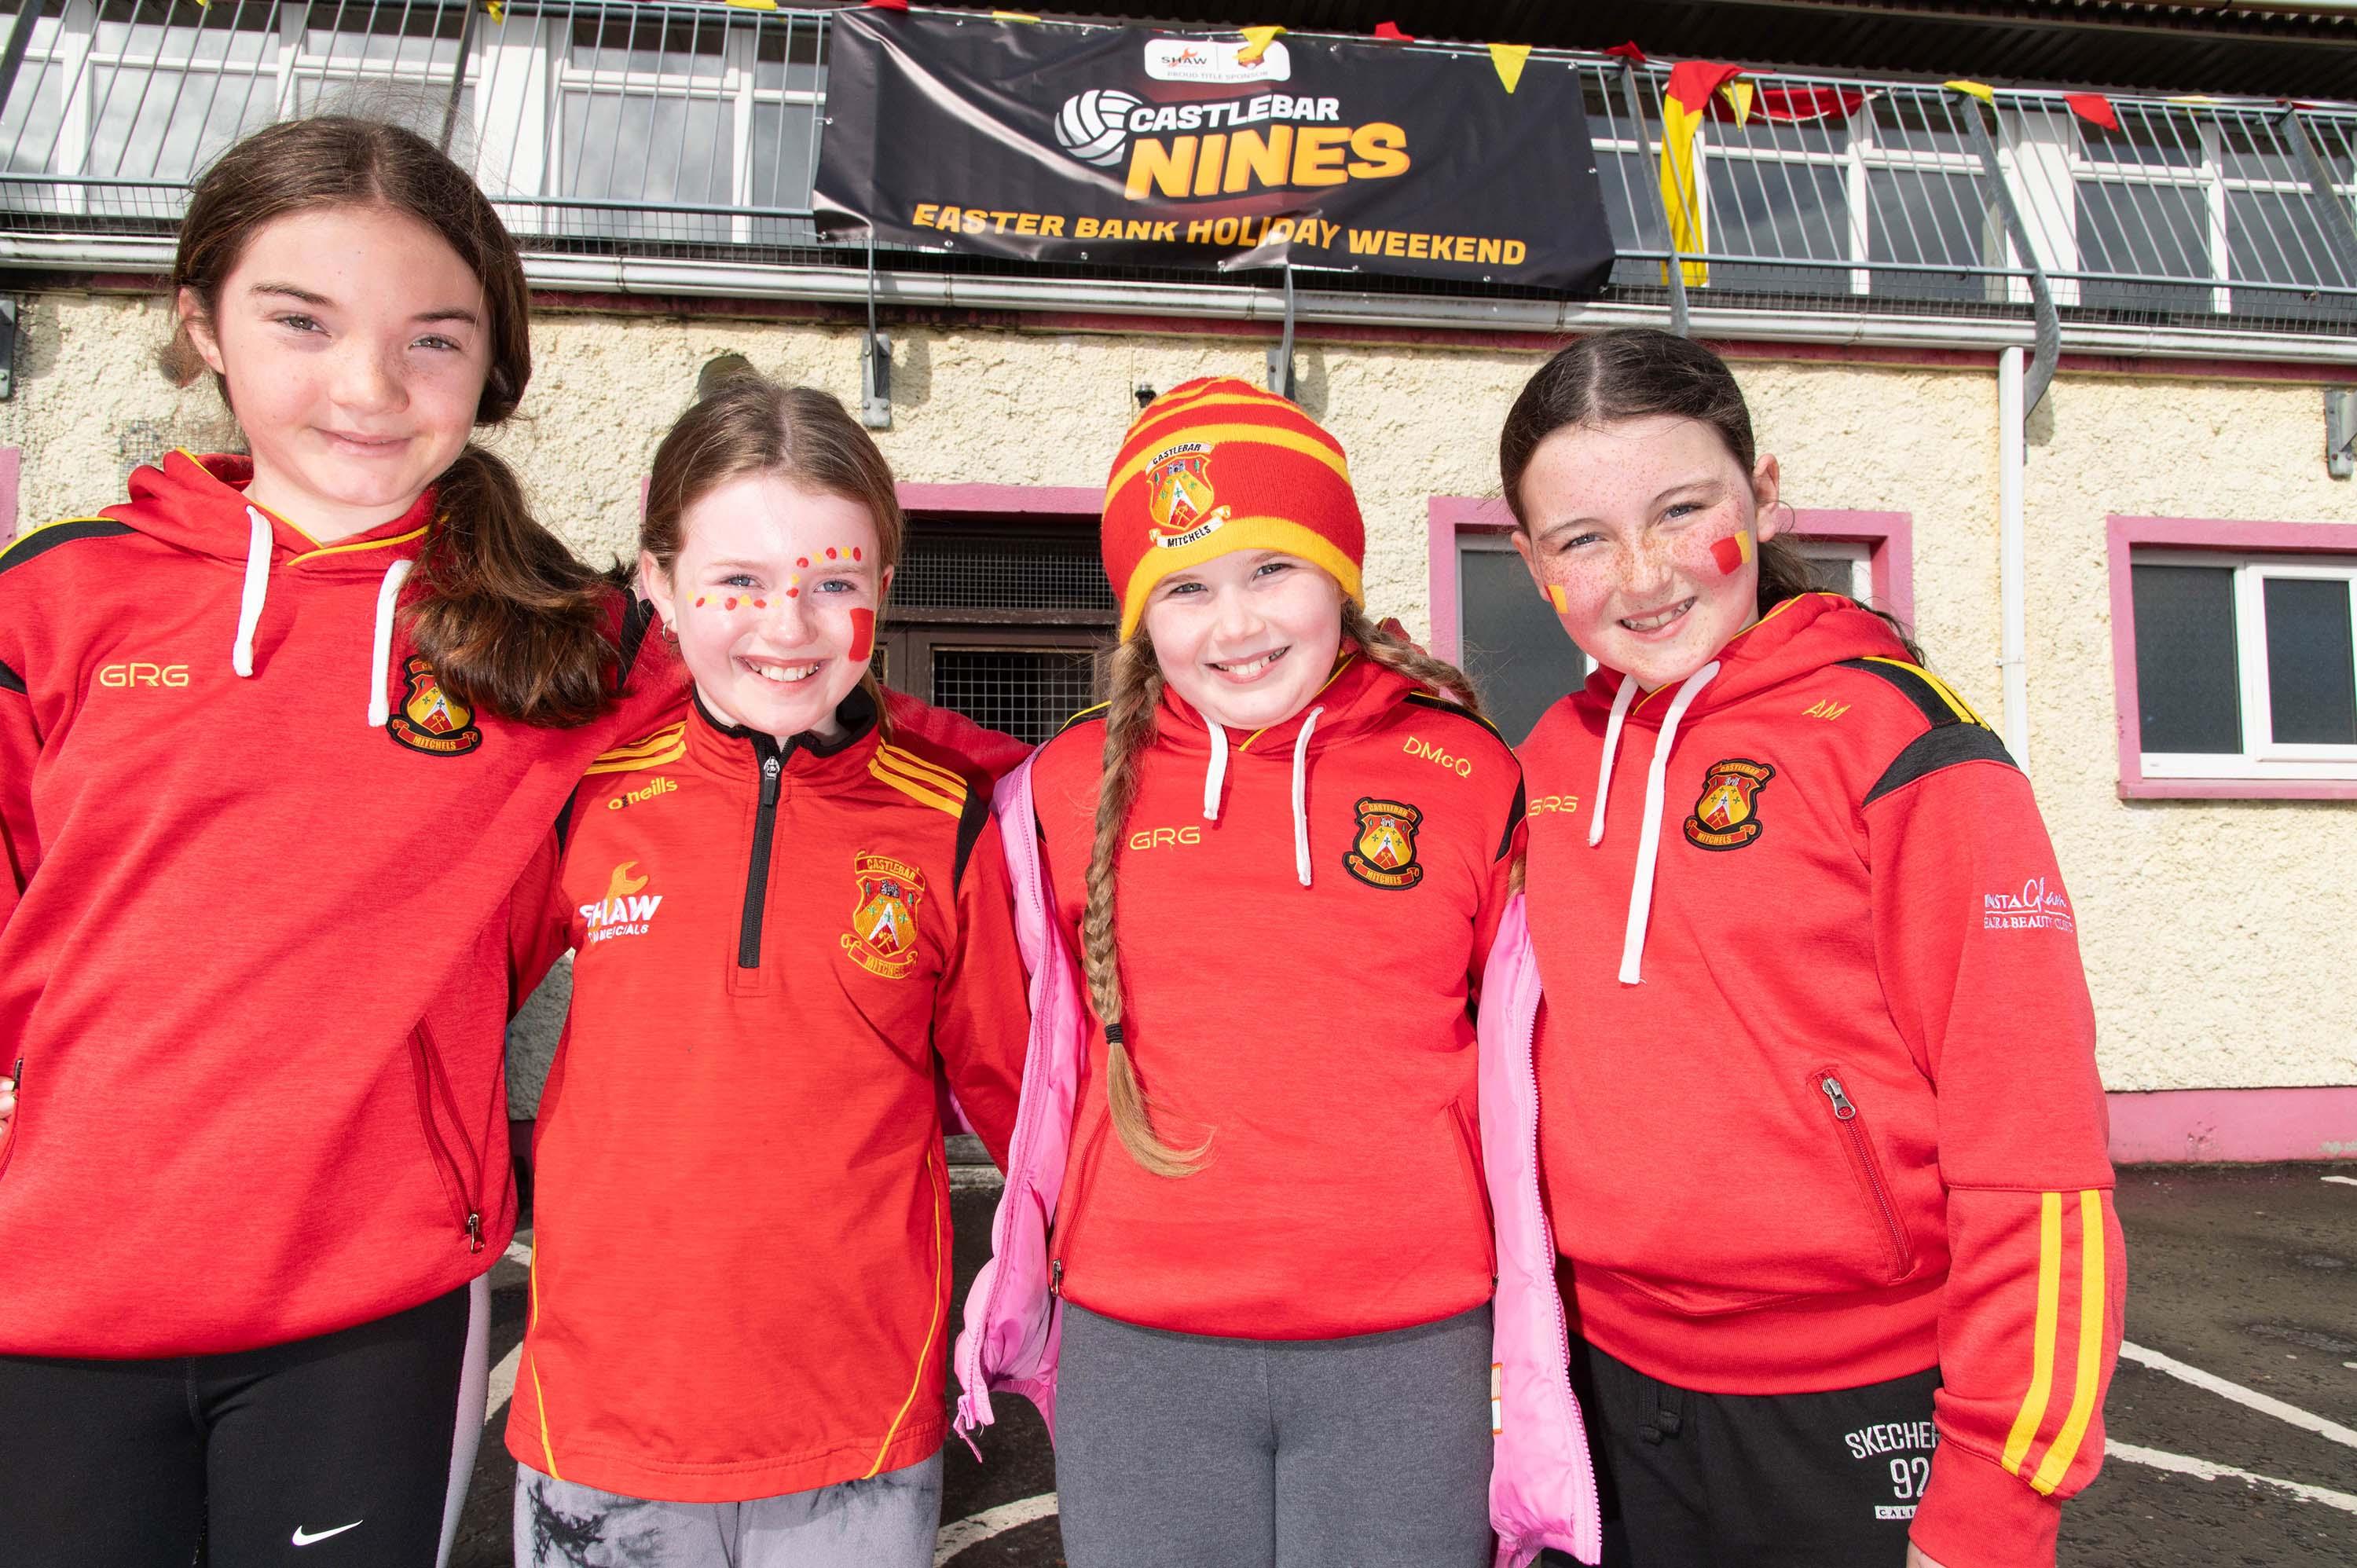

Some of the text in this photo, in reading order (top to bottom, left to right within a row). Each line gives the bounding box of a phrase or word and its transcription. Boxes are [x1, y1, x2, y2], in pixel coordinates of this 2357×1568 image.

[1161, 55, 1208, 64] SHAW
[1129, 93, 1340, 132] CASTLEBAR
[1124, 123, 1411, 200] NINES
[912, 203, 1526, 265] EASTER BANK HOLIDAY WEEKEND
[1153, 443, 1201, 465] CASTLEBAR
[1167, 525, 1211, 548] MITCHELS
[100, 662, 189, 687] GRG
[1802, 698, 1851, 721] AM
[412, 735, 456, 750] MITCHELS
[1402, 736, 1472, 779] DMcQ
[1130, 826, 1200, 850] GRG
[1696, 832, 1732, 844] MITCHELS
[867, 859, 915, 881] CASTLEBAR
[1365, 870, 1402, 884] MITCHELS
[1890, 1457, 1930, 1498] 92
